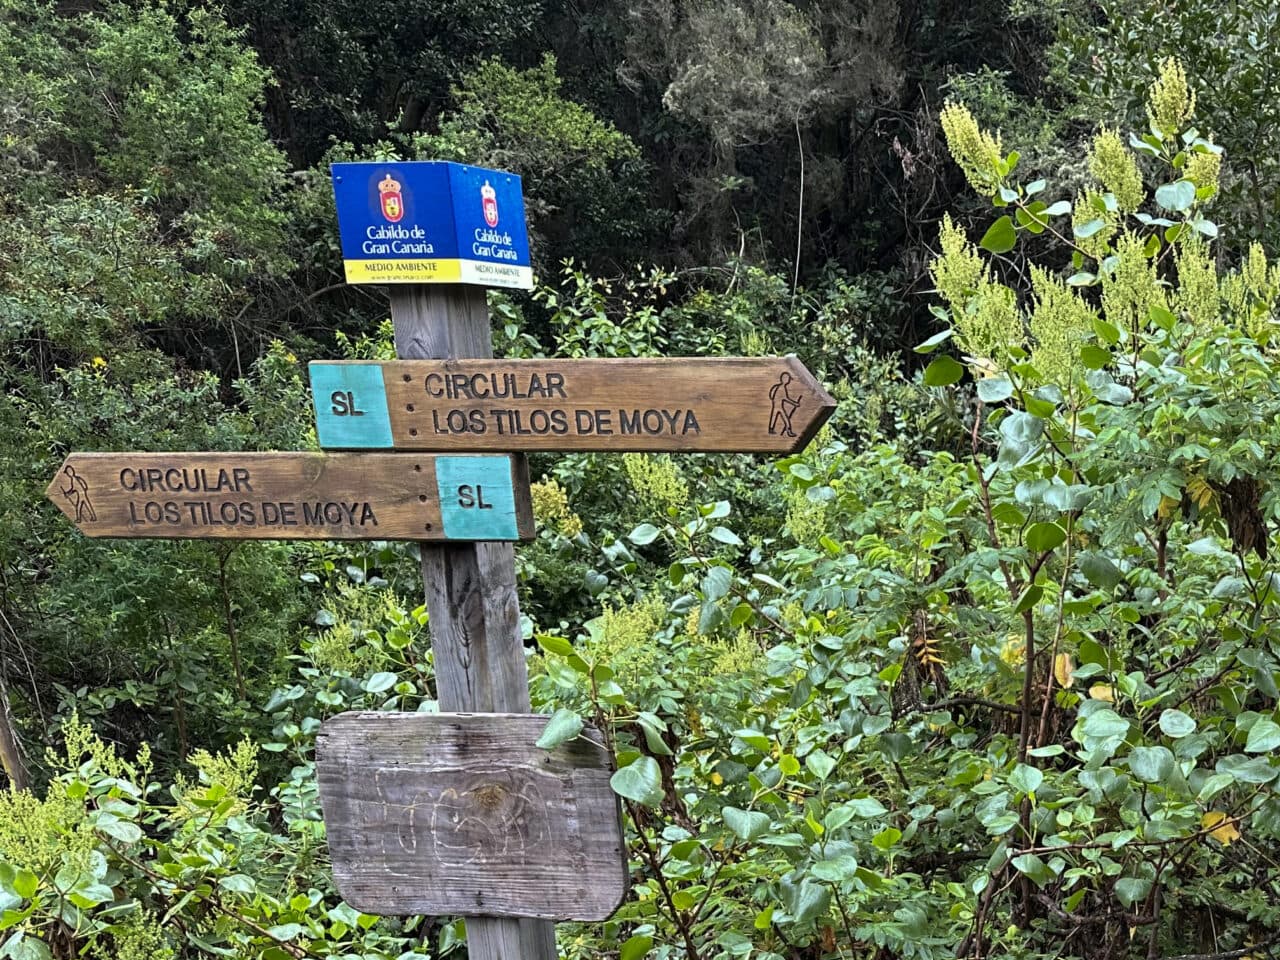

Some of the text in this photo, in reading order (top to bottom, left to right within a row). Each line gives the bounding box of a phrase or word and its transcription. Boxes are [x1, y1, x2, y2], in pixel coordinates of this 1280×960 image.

[367, 225, 425, 239] Cabildo de
[475, 229, 512, 245] Cabildo de
[363, 241, 433, 254] Gran Canaria
[473, 242, 517, 260] Gran Canaria
[364, 262, 438, 272] MEDIO AMBIENTE
[424, 372, 568, 400] CIRCULAR
[331, 390, 364, 417] SL
[432, 408, 701, 436] LOS TILOS DE MOYA
[119, 467, 254, 493] CIRCULAR
[457, 484, 493, 510] SL
[129, 501, 378, 527] LOS TILOS DE MOYA
